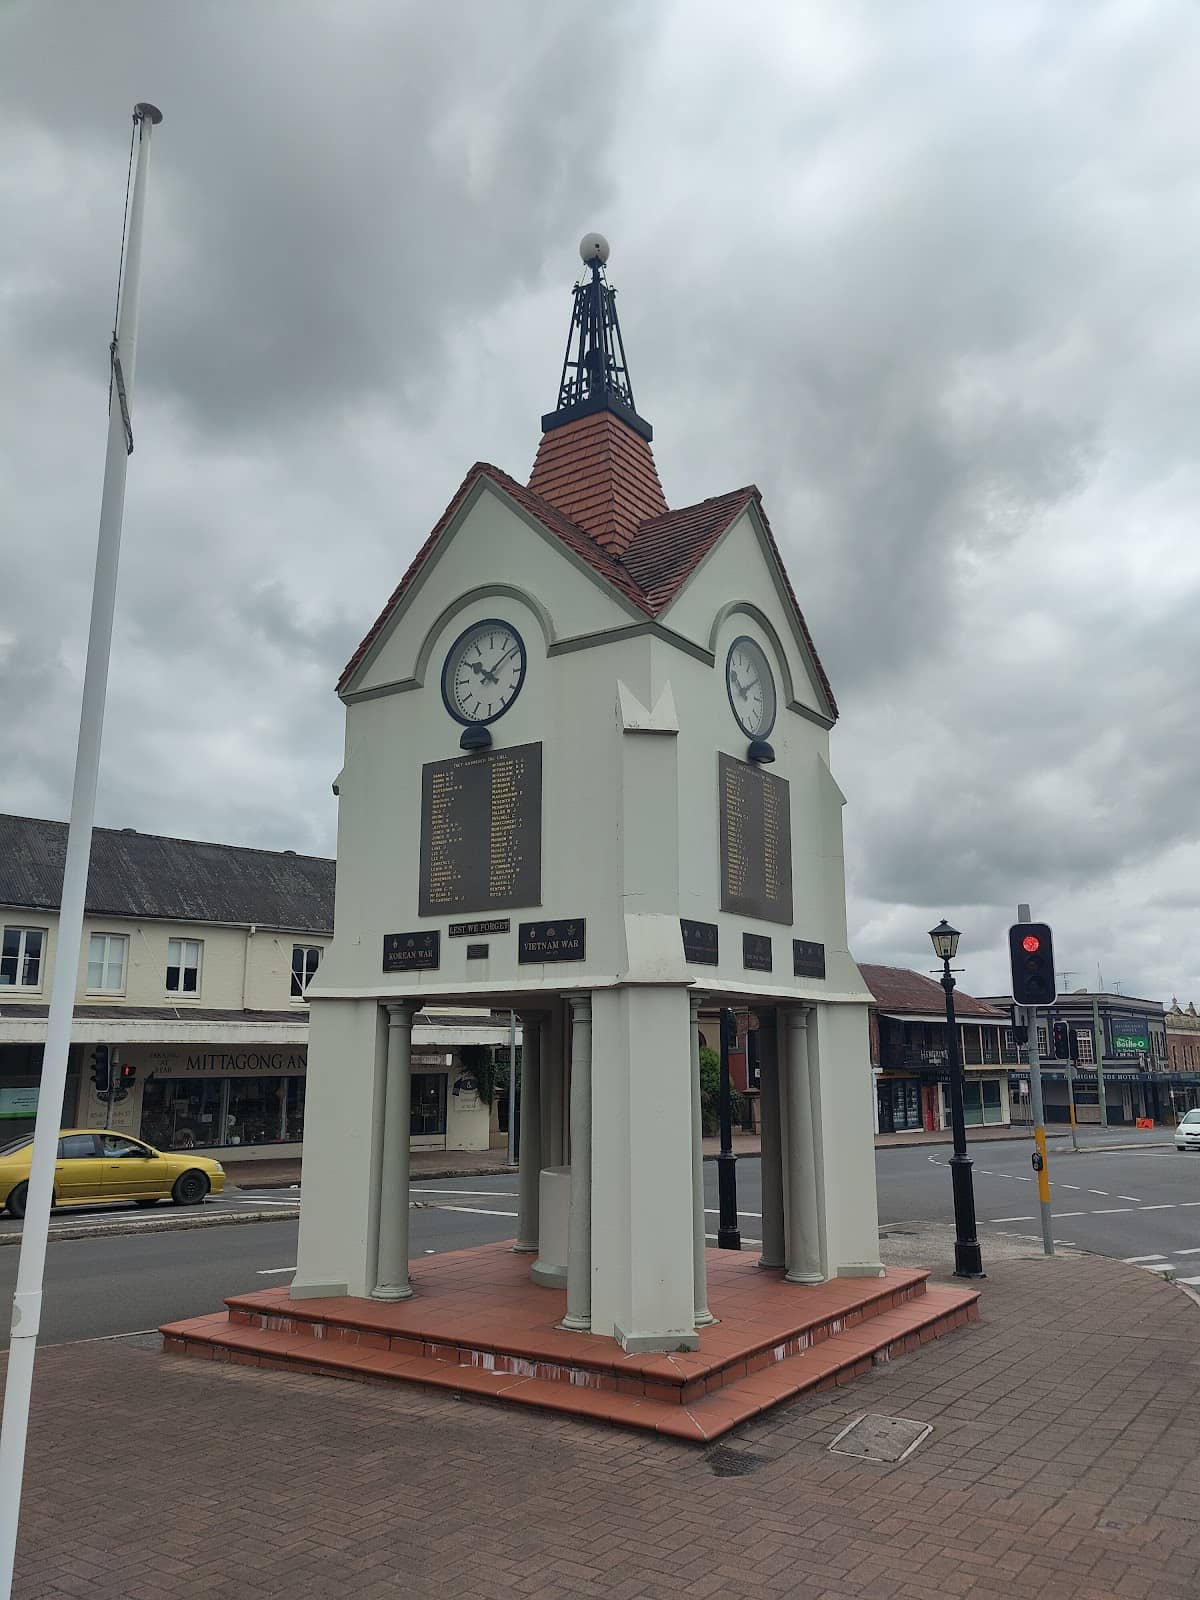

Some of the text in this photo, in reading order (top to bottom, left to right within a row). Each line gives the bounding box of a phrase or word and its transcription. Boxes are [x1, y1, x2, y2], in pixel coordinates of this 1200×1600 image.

[449, 921, 509, 935] LEST WE FORGET
[524, 940, 579, 951] VIETNAM WAR
[389, 949, 433, 960] KOREAN WAR
[185, 1054, 283, 1071] MITTAGONG
